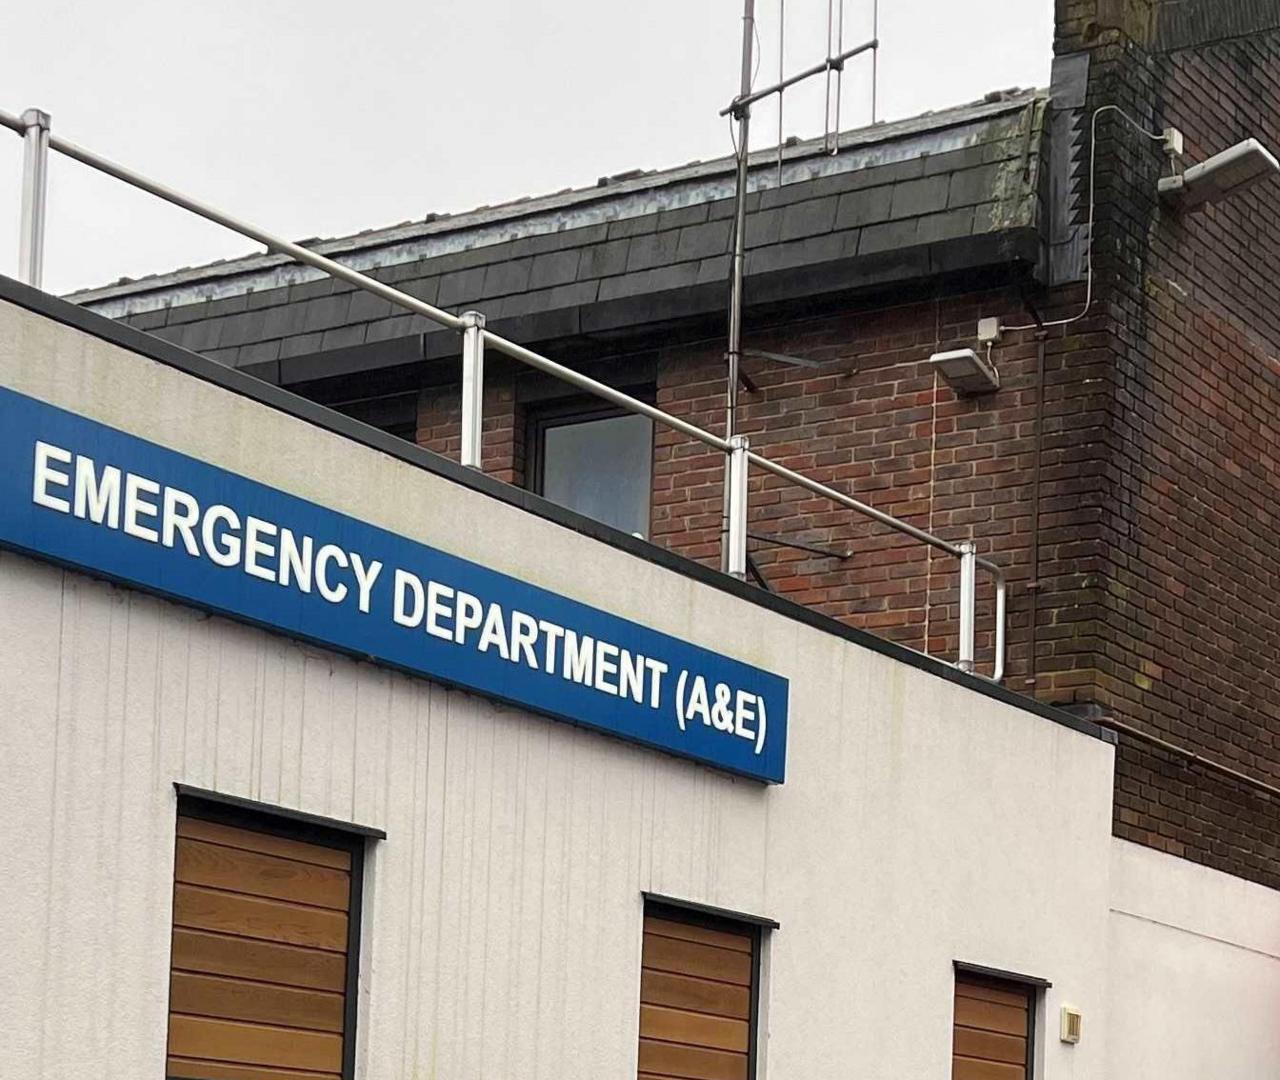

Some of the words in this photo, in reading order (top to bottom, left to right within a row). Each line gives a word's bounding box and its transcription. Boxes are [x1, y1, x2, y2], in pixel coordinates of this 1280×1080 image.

[32, 440, 383, 614] EMERGENCY
[393, 568, 668, 709] DEPARTMENT
[675, 669, 768, 755] (A&E)
